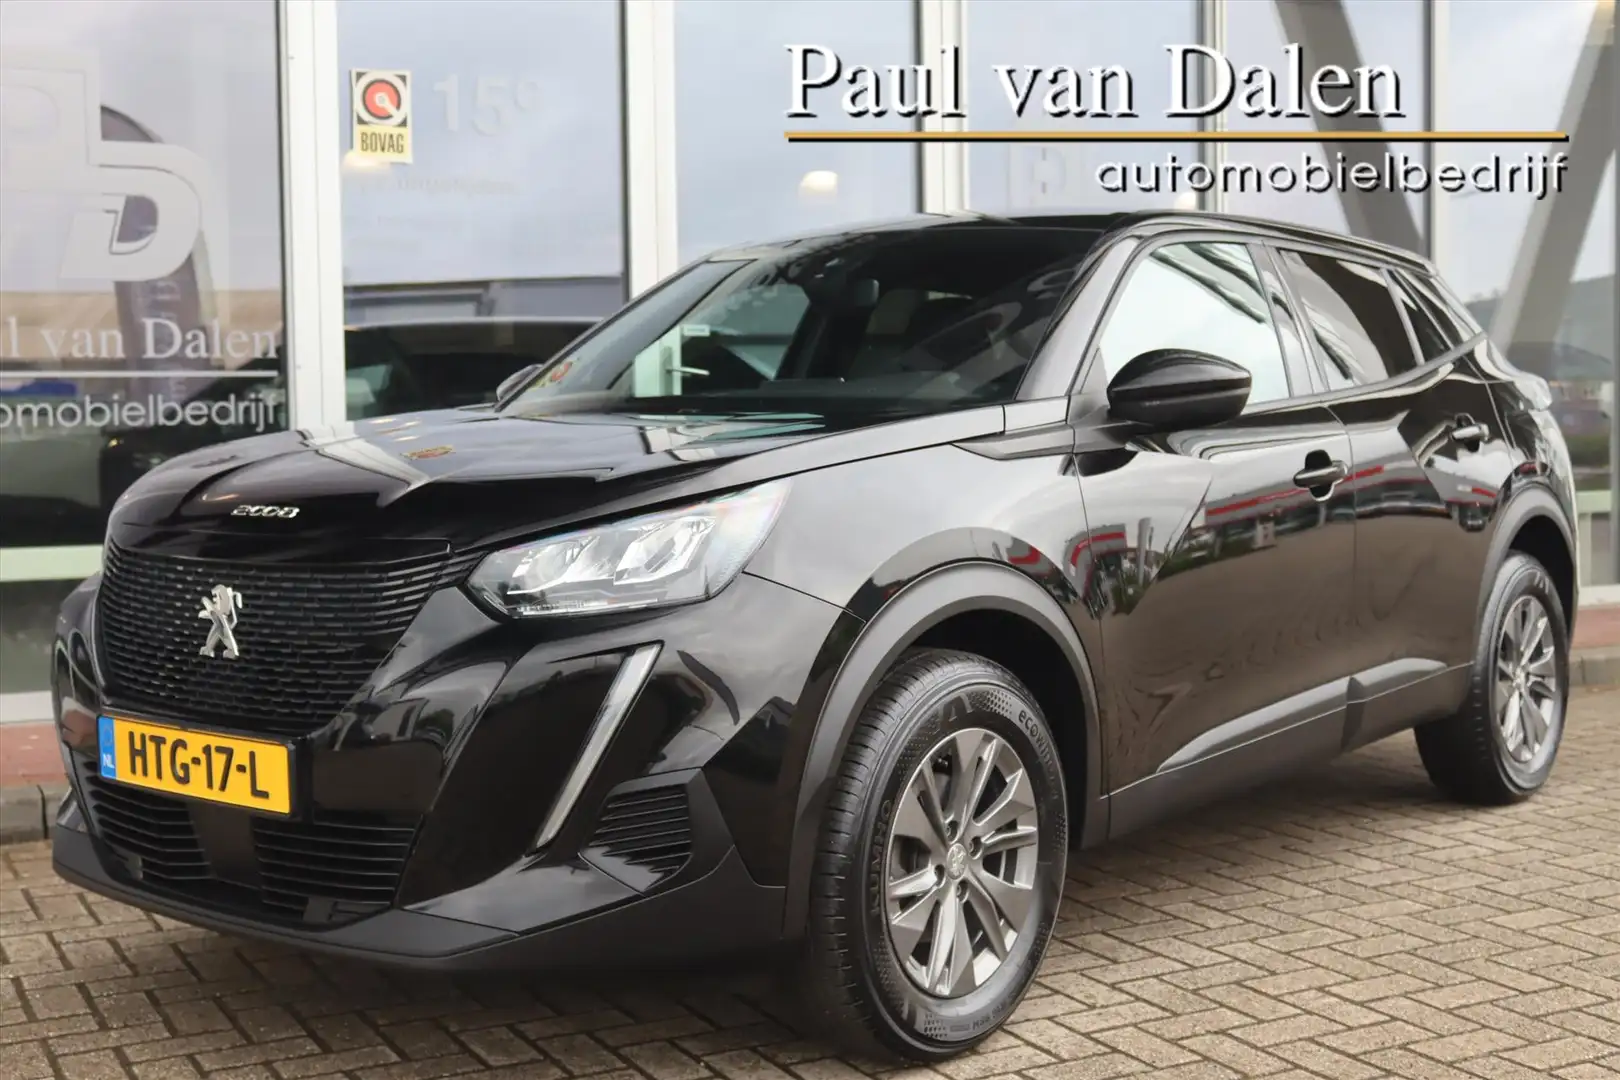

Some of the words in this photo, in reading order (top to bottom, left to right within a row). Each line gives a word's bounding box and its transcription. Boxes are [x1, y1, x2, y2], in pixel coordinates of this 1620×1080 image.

[360, 131, 405, 154] BOVAG
[40, 327, 126, 359] van
[141, 316, 279, 359] Dalen
[230, 504, 300, 518] 2008
[102, 752, 116, 768] NL
[128, 731, 269, 799] HTG-17-L
